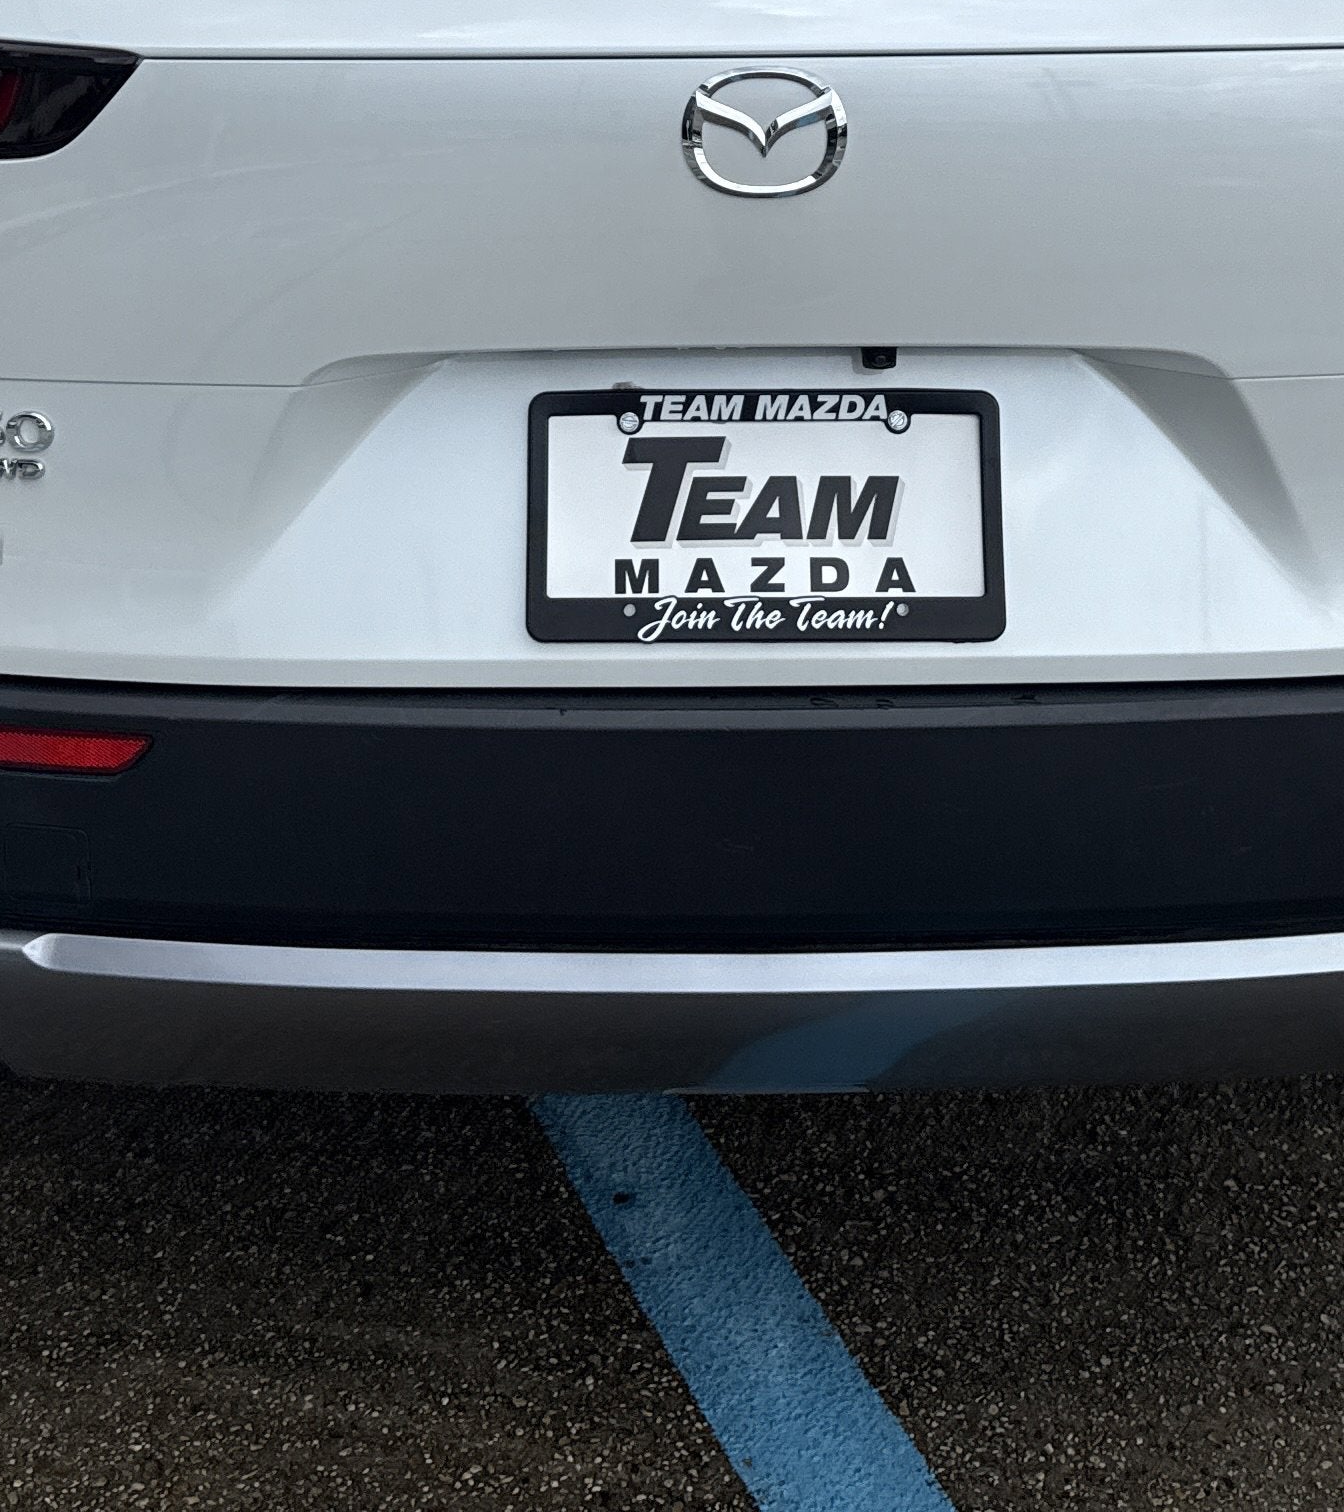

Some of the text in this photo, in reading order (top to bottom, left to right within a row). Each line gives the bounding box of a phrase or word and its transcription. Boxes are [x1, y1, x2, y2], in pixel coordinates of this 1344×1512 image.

[640, 394, 889, 421] TEAM MAZDA
[621, 435, 902, 544] TEAM
[613, 556, 916, 595] MAZDA
[637, 596, 895, 642] Join The Team!
